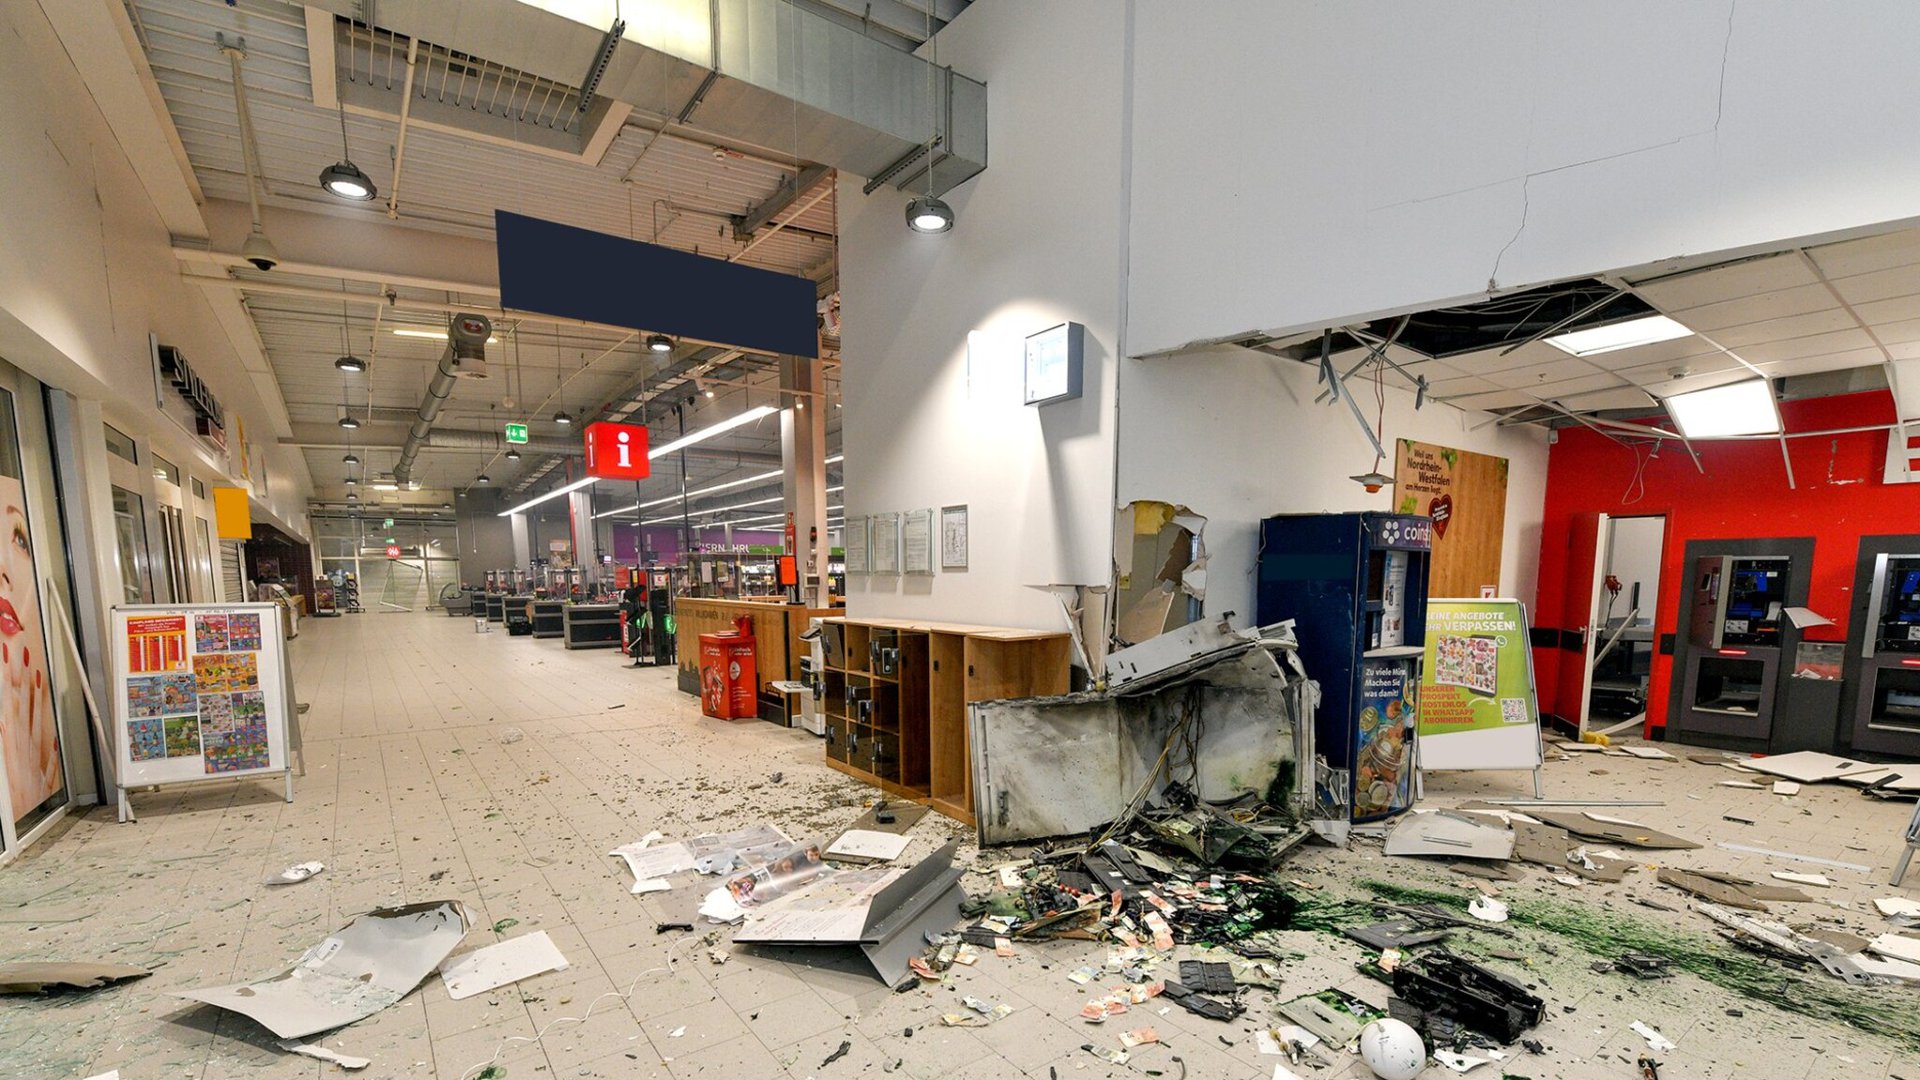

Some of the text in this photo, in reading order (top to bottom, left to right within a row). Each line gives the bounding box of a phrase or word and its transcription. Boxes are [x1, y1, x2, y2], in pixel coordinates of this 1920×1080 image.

[1406, 457, 1442, 472] Nordrhein-
[1418, 471, 1450, 486] Westfalen
[1427, 612, 1505, 620] EINE ANGEBOTE
[1443, 621, 1517, 632] VERPASSEN!
[1375, 668, 1391, 676] viele
[1364, 679, 1401, 687] Machen Sie
[1378, 689, 1399, 698] damit!
